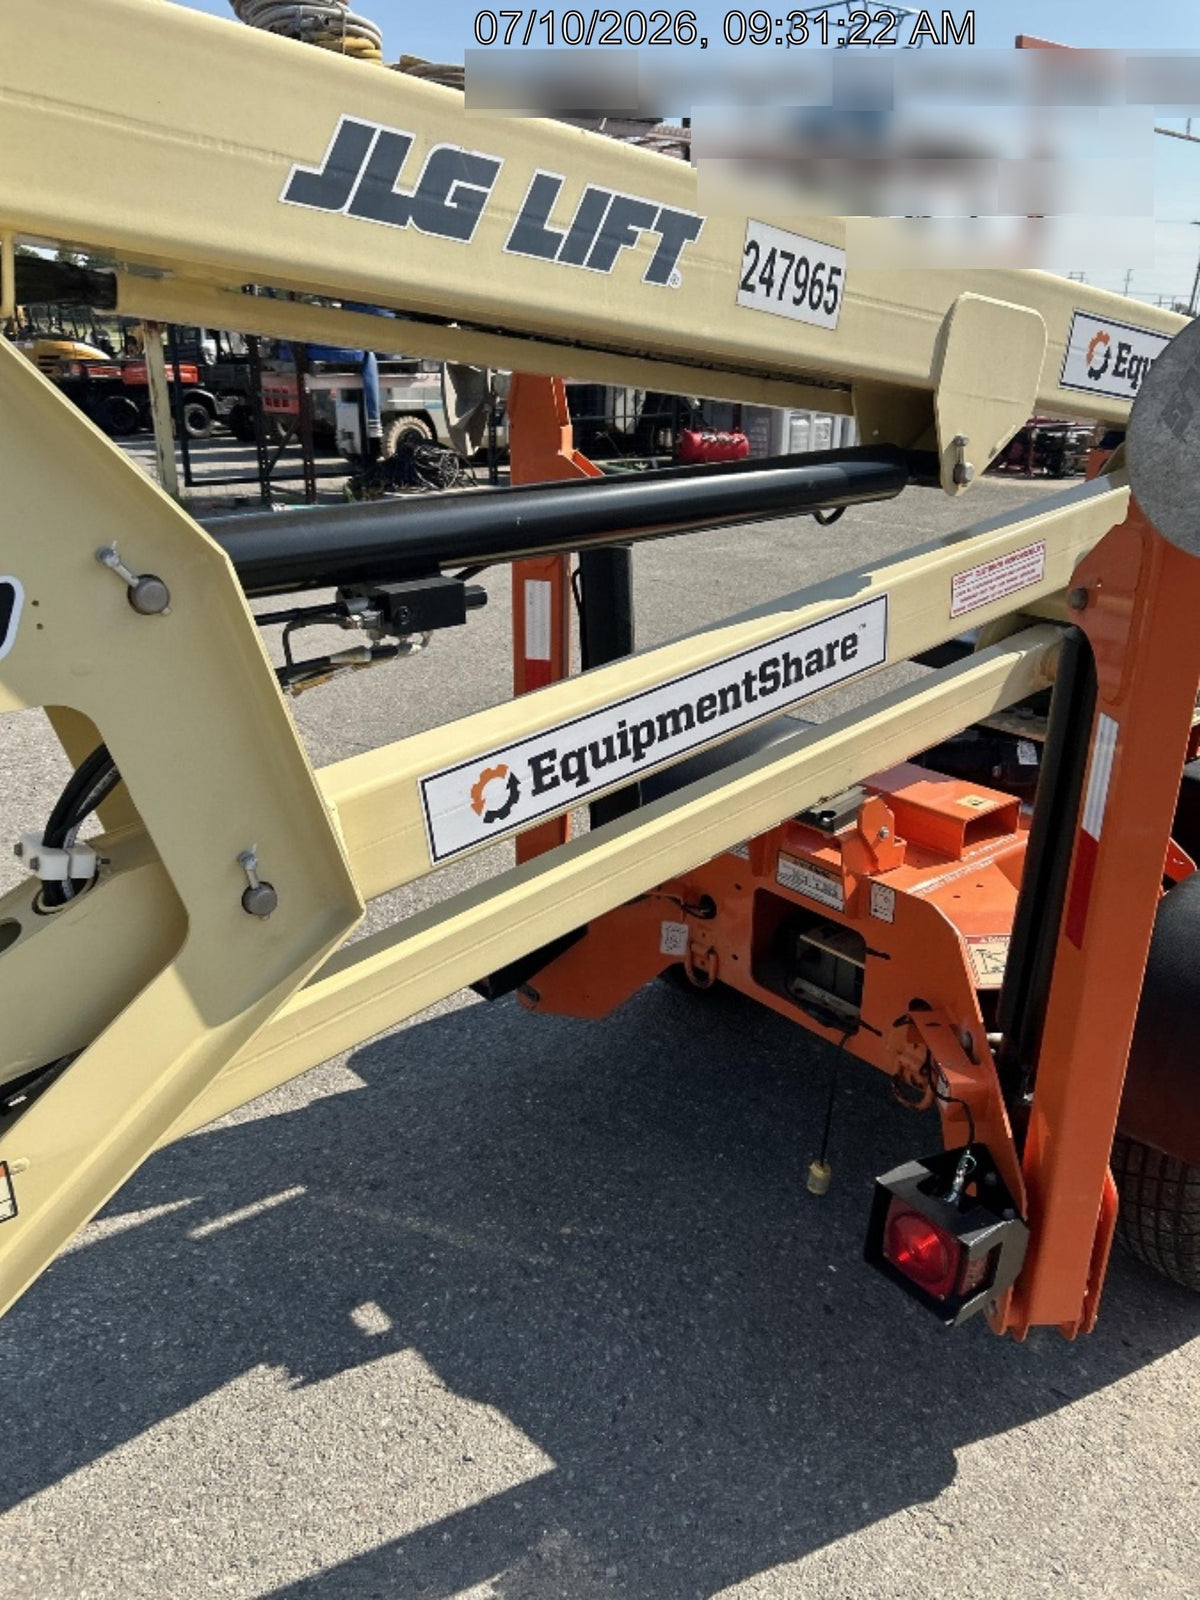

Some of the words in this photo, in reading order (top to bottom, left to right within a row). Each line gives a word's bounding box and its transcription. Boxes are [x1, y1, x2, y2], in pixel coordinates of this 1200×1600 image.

[280, 114, 504, 243] JLG
[504, 169, 706, 286] LIFT
[740, 239, 842, 315] 247965
[527, 631, 858, 797] EquipmentShare
